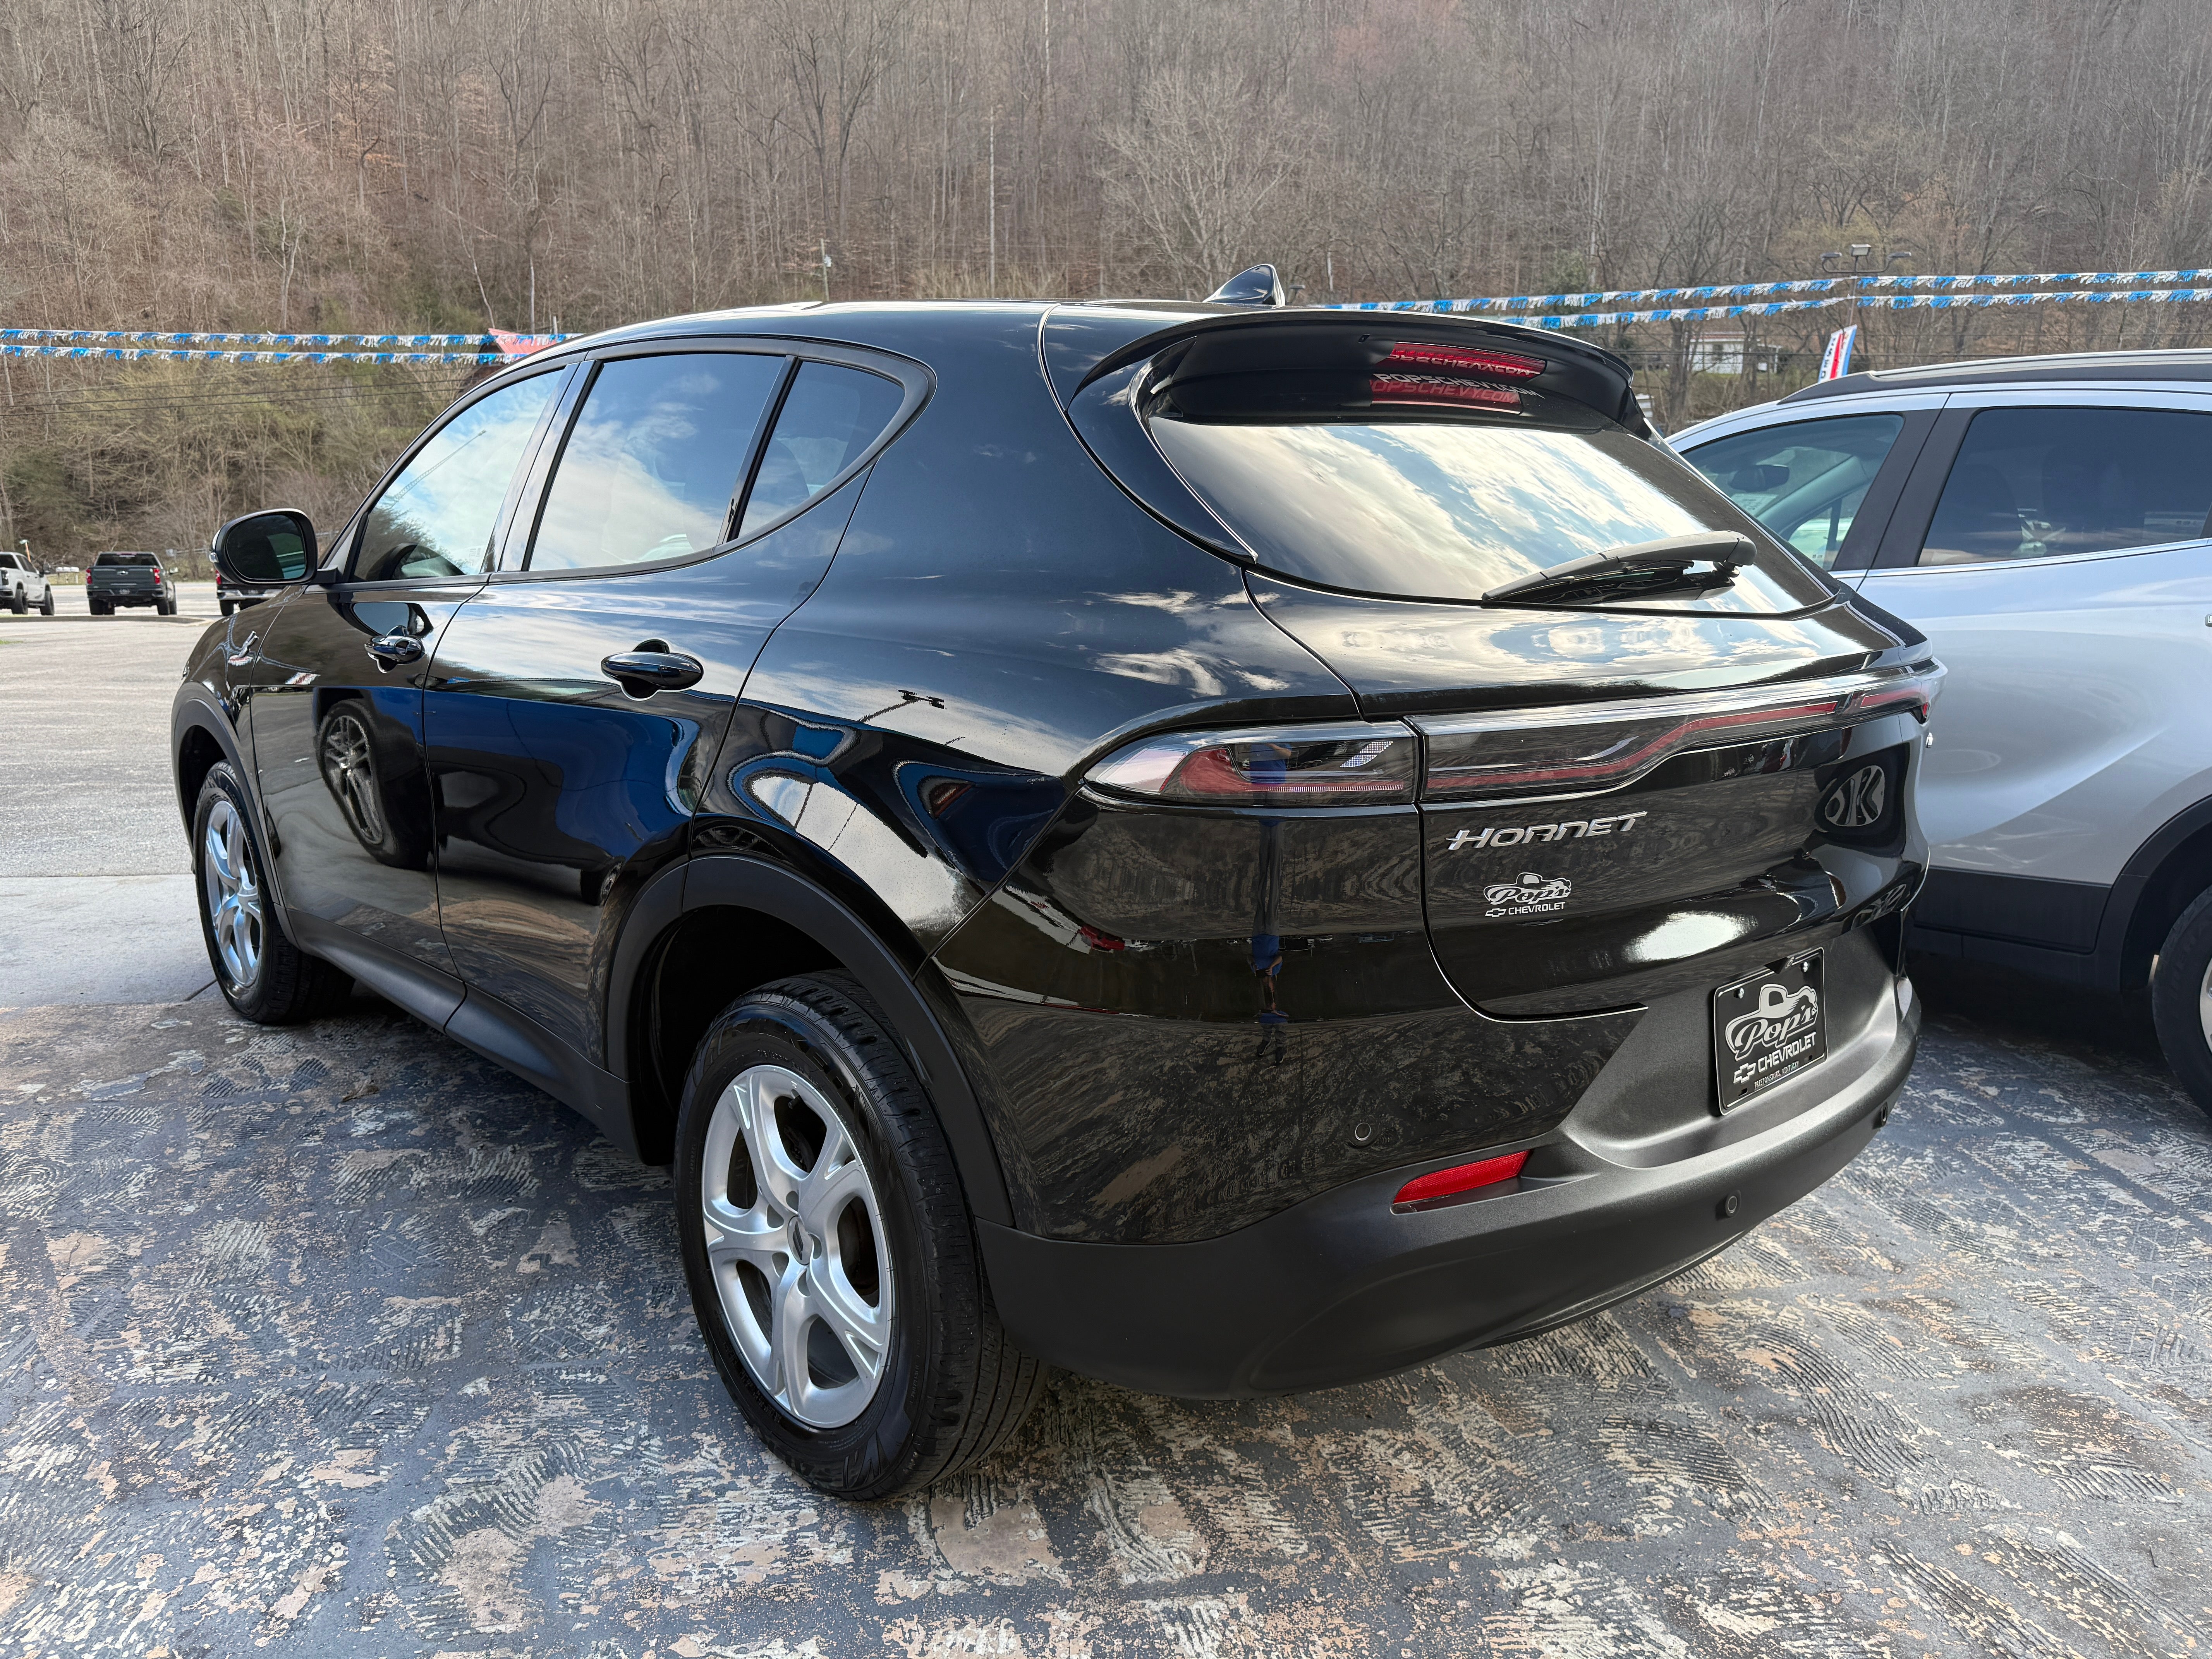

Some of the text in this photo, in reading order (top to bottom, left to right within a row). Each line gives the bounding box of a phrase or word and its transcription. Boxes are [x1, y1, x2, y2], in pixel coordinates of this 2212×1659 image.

[1370, 380, 1518, 404] OPSCHEVY.COM
[1373, 373, 1545, 399] POPSCHEVY.COM
[1445, 811, 1647, 850] HORNET
[1508, 902, 1566, 915] CHEVROLET
[1735, 1005, 1814, 1053] Pop's
[1758, 1032, 1816, 1073] CHEVROLET
